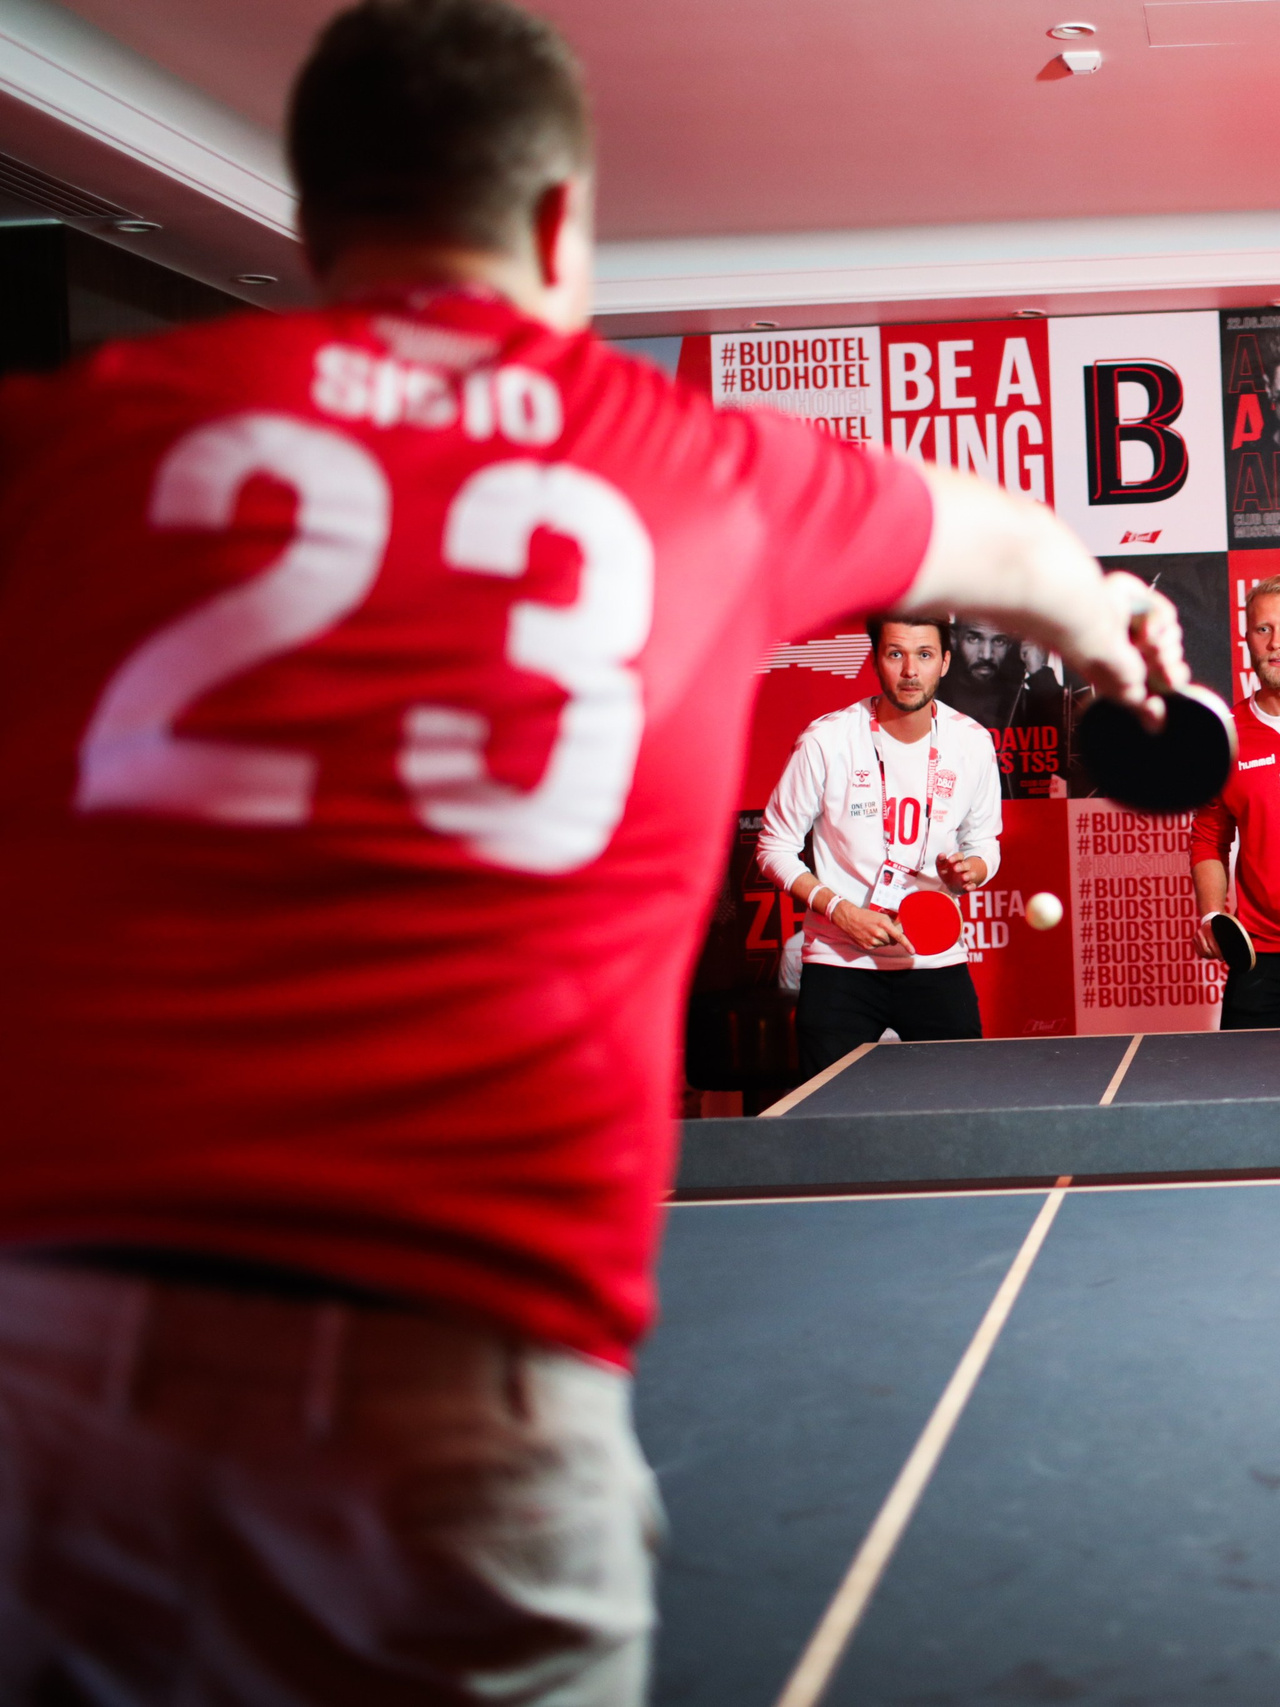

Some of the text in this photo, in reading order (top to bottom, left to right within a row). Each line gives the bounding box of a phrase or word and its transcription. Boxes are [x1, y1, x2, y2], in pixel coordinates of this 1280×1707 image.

[721, 337, 870, 367] #BUDHOTEL
[721, 364, 871, 393] #BUDHOTEL
[889, 337, 1042, 412] BE A
[1083, 357, 1190, 507] B
[75, 410, 655, 876] 23
[1018, 750, 1060, 774] TS5
[1238, 753, 1276, 771] hummel
[850, 807, 879, 817] THE TEAM
[851, 801, 876, 811] ONE FOR
[884, 796, 921, 846] 10
[1077, 832, 1190, 855] #BUDSTUD
[1078, 876, 1193, 899] #BUDSTUD
[969, 890, 1026, 919] FIFA
[962, 921, 1009, 950] RLD
